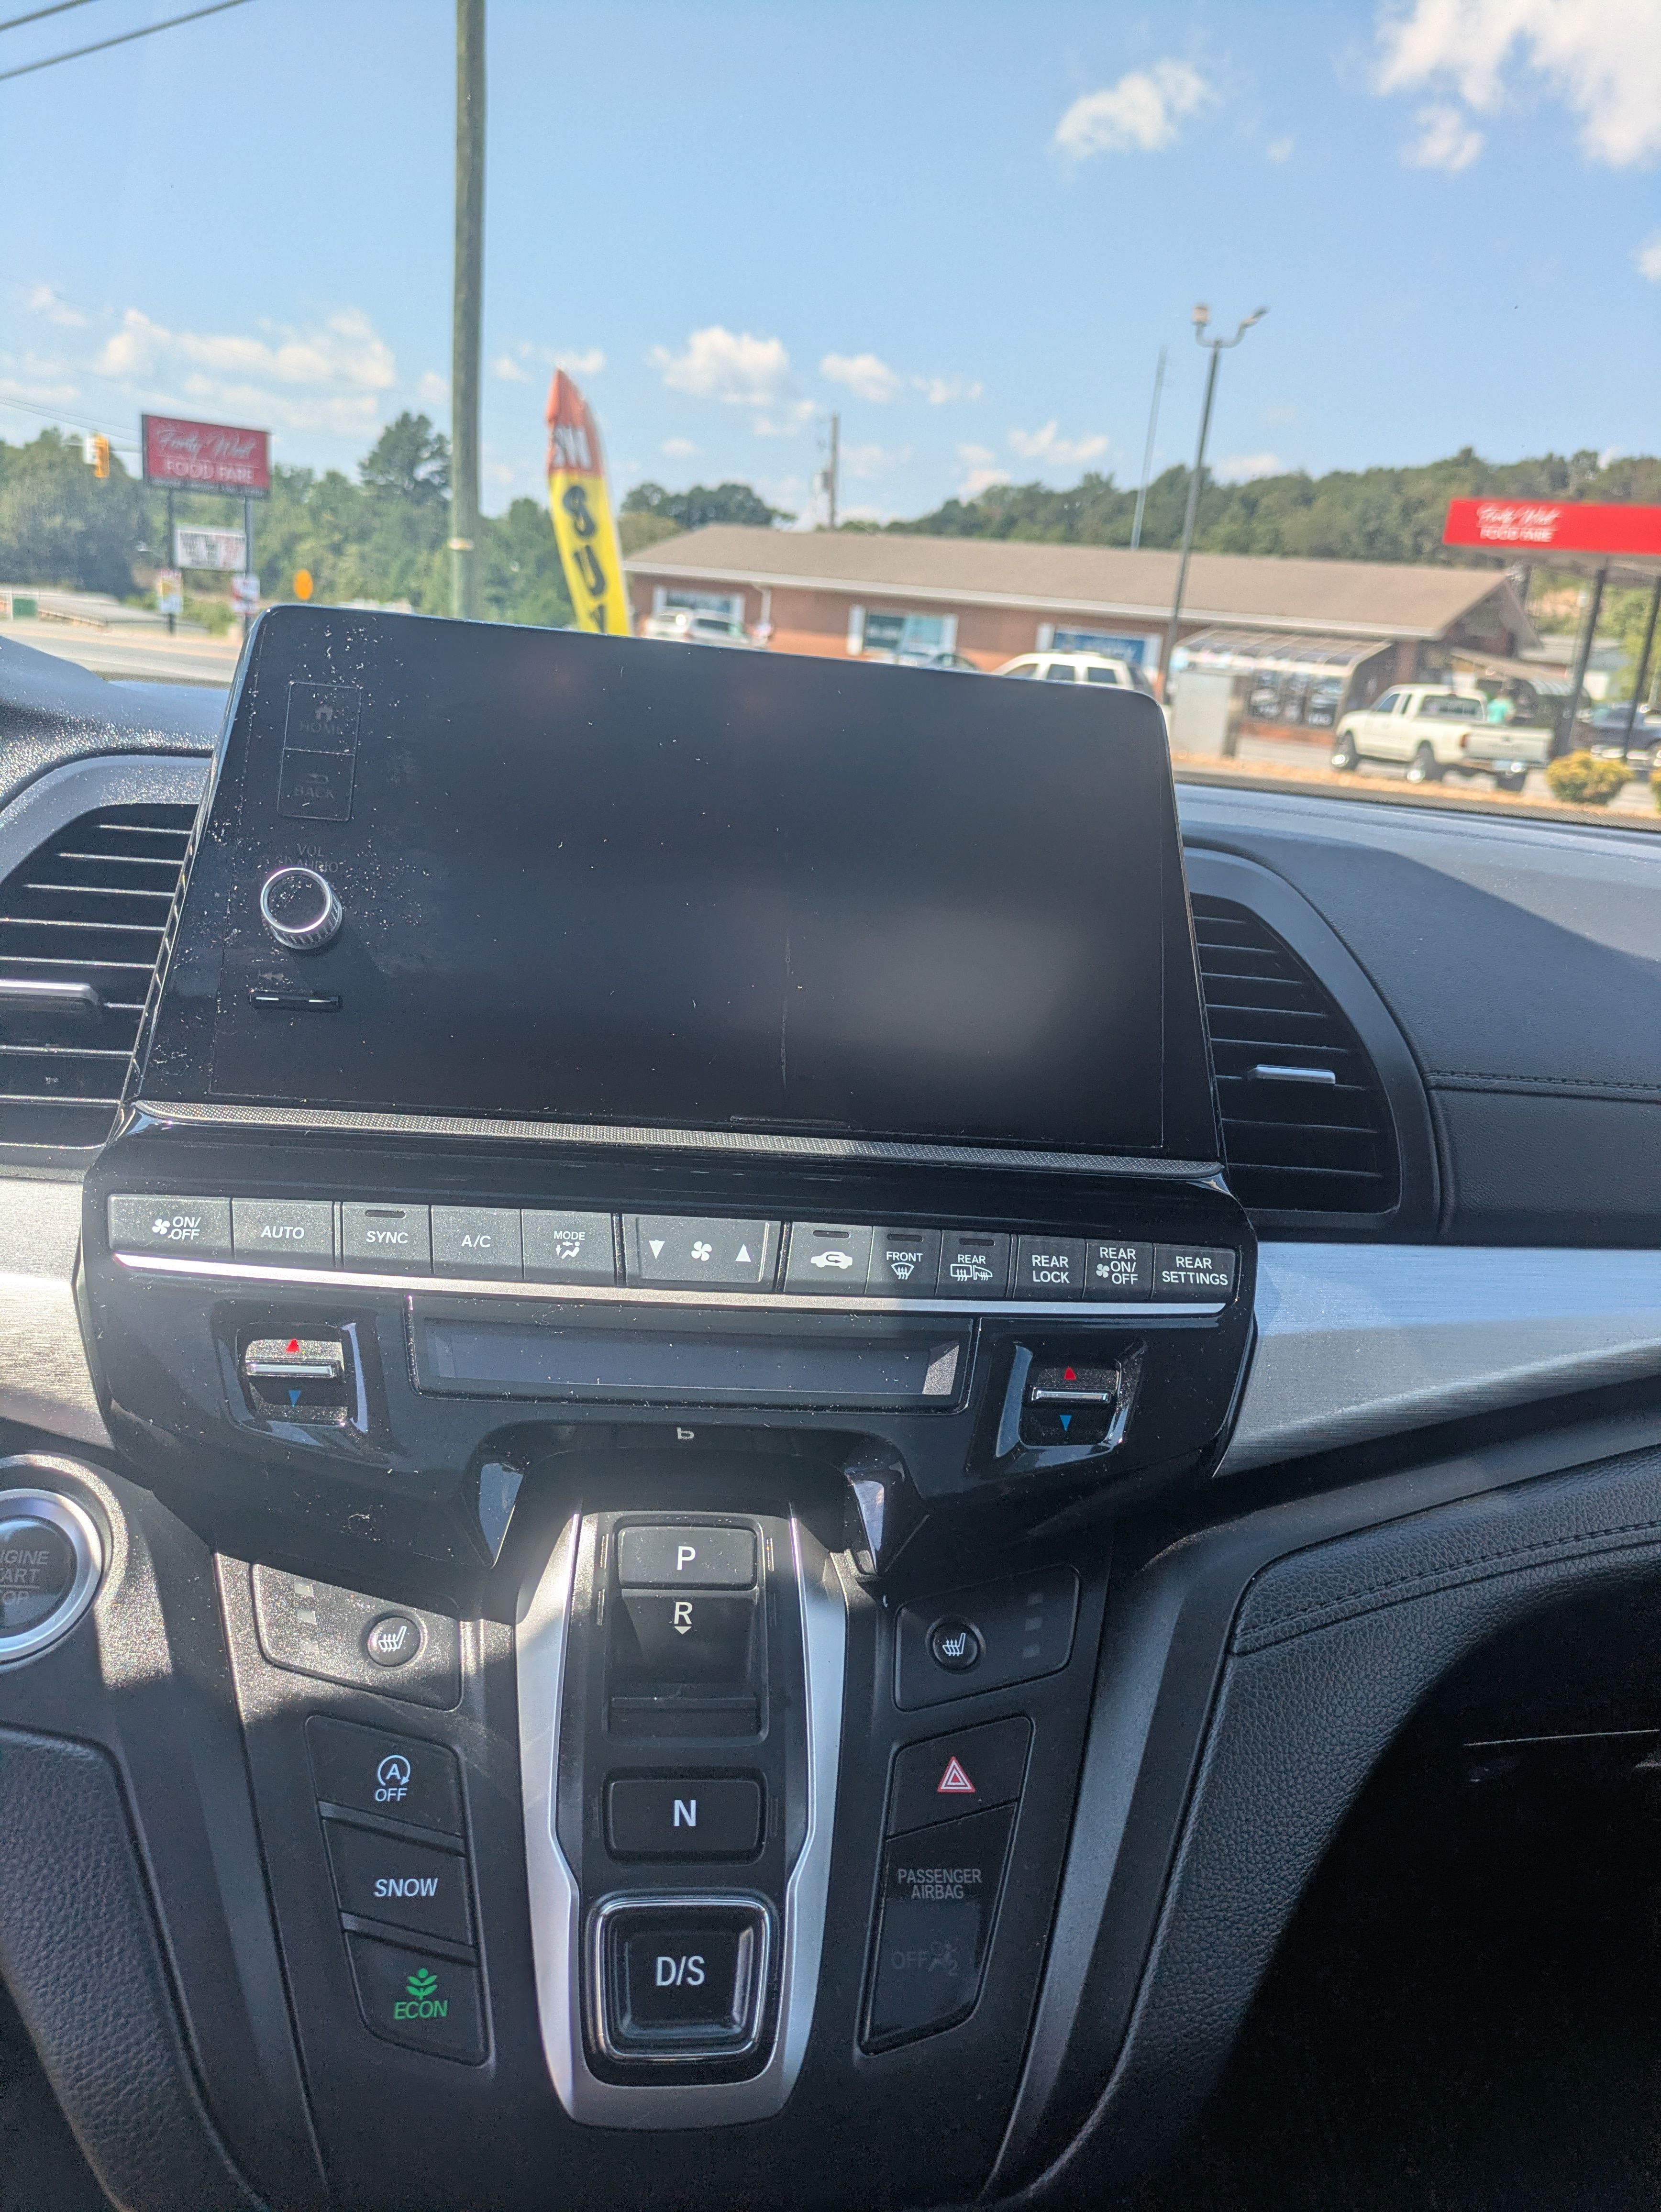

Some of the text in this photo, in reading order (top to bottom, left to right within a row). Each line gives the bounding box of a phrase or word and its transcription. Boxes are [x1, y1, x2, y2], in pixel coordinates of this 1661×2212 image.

[294, 785, 335, 799] BACK
[172, 1216, 202, 1229] ON/
[170, 1228, 200, 1241] OFF
[260, 1225, 305, 1239] AUTO
[365, 1230, 409, 1244] SYNC
[553, 1230, 586, 1241] MODE
[461, 1234, 492, 1249] A/C
[886, 1250, 924, 1263] FRONT
[957, 1254, 986, 1265] REAR
[1099, 1246, 1137, 1261] REAR
[1031, 1254, 1069, 1269] REAR
[1110, 1260, 1137, 1273] ON/
[1175, 1256, 1213, 1270] REAR
[1032, 1270, 1070, 1284] LOCK
[1111, 1272, 1139, 1285] OFF
[1162, 1270, 1229, 1286] SETTINGS
[0, 1549, 50, 1565] GINE
[676, 1545, 696, 1571] P
[0, 1568, 41, 1583] ART
[673, 1601, 693, 1625] R
[374, 1787, 408, 1802] OFF
[673, 1799, 697, 1827] N
[897, 1868, 982, 1884] PASSENGER
[374, 1878, 439, 1898] SNOW
[910, 1884, 964, 1900] AIRBAG
[891, 1950, 928, 1969] OFF
[656, 1955, 706, 1987] D/S
[394, 2000, 448, 2020] ECON
